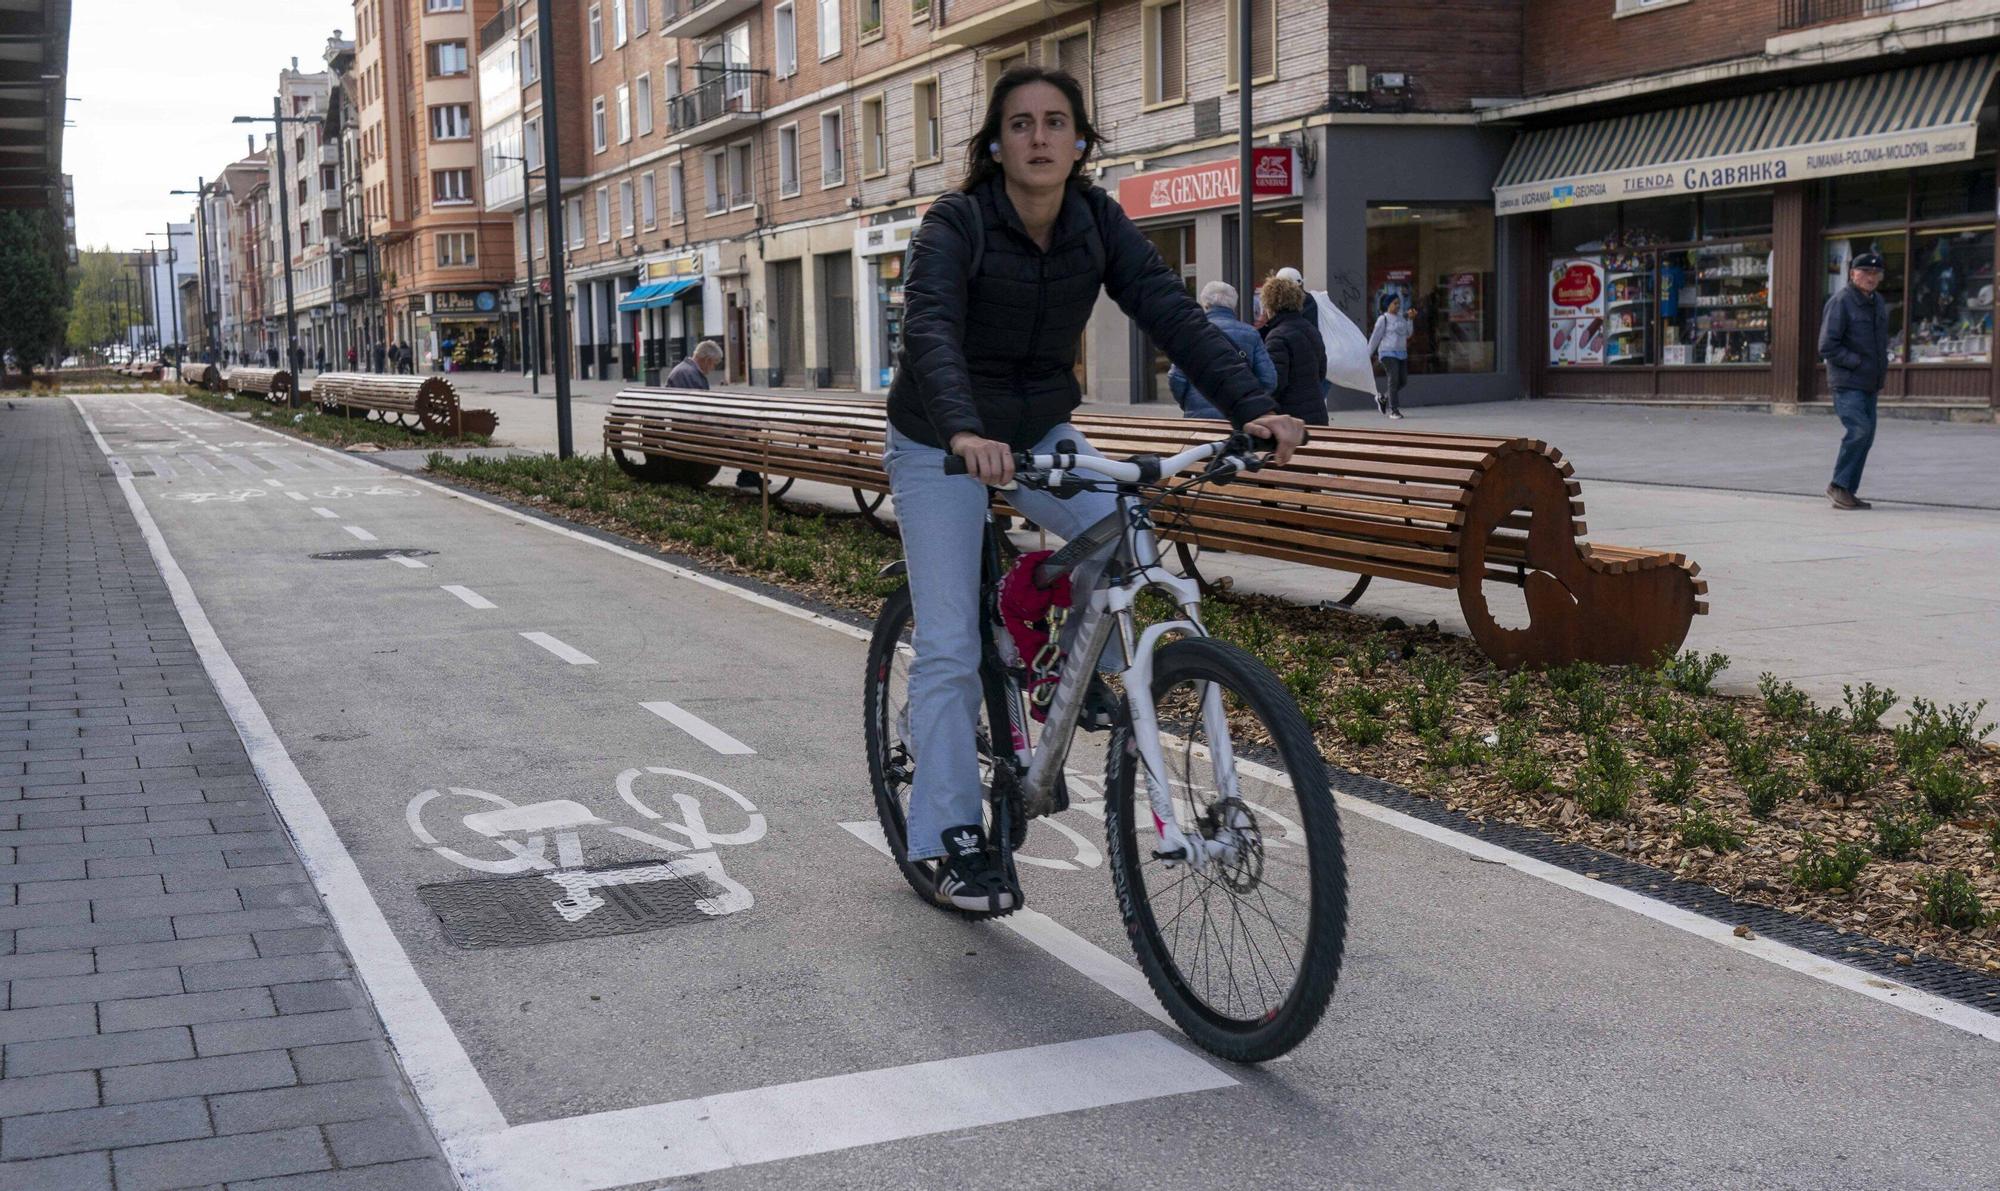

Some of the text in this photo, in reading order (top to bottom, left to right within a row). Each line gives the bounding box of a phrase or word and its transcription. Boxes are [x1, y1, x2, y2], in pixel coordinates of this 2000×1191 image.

[1256, 177, 1288, 187] GENERALI
[1623, 174, 1675, 190] TIENDA
[1684, 160, 1787, 190] Славянка
[1171, 168, 1241, 205] GENERAL
[960, 847, 980, 856] adidas
